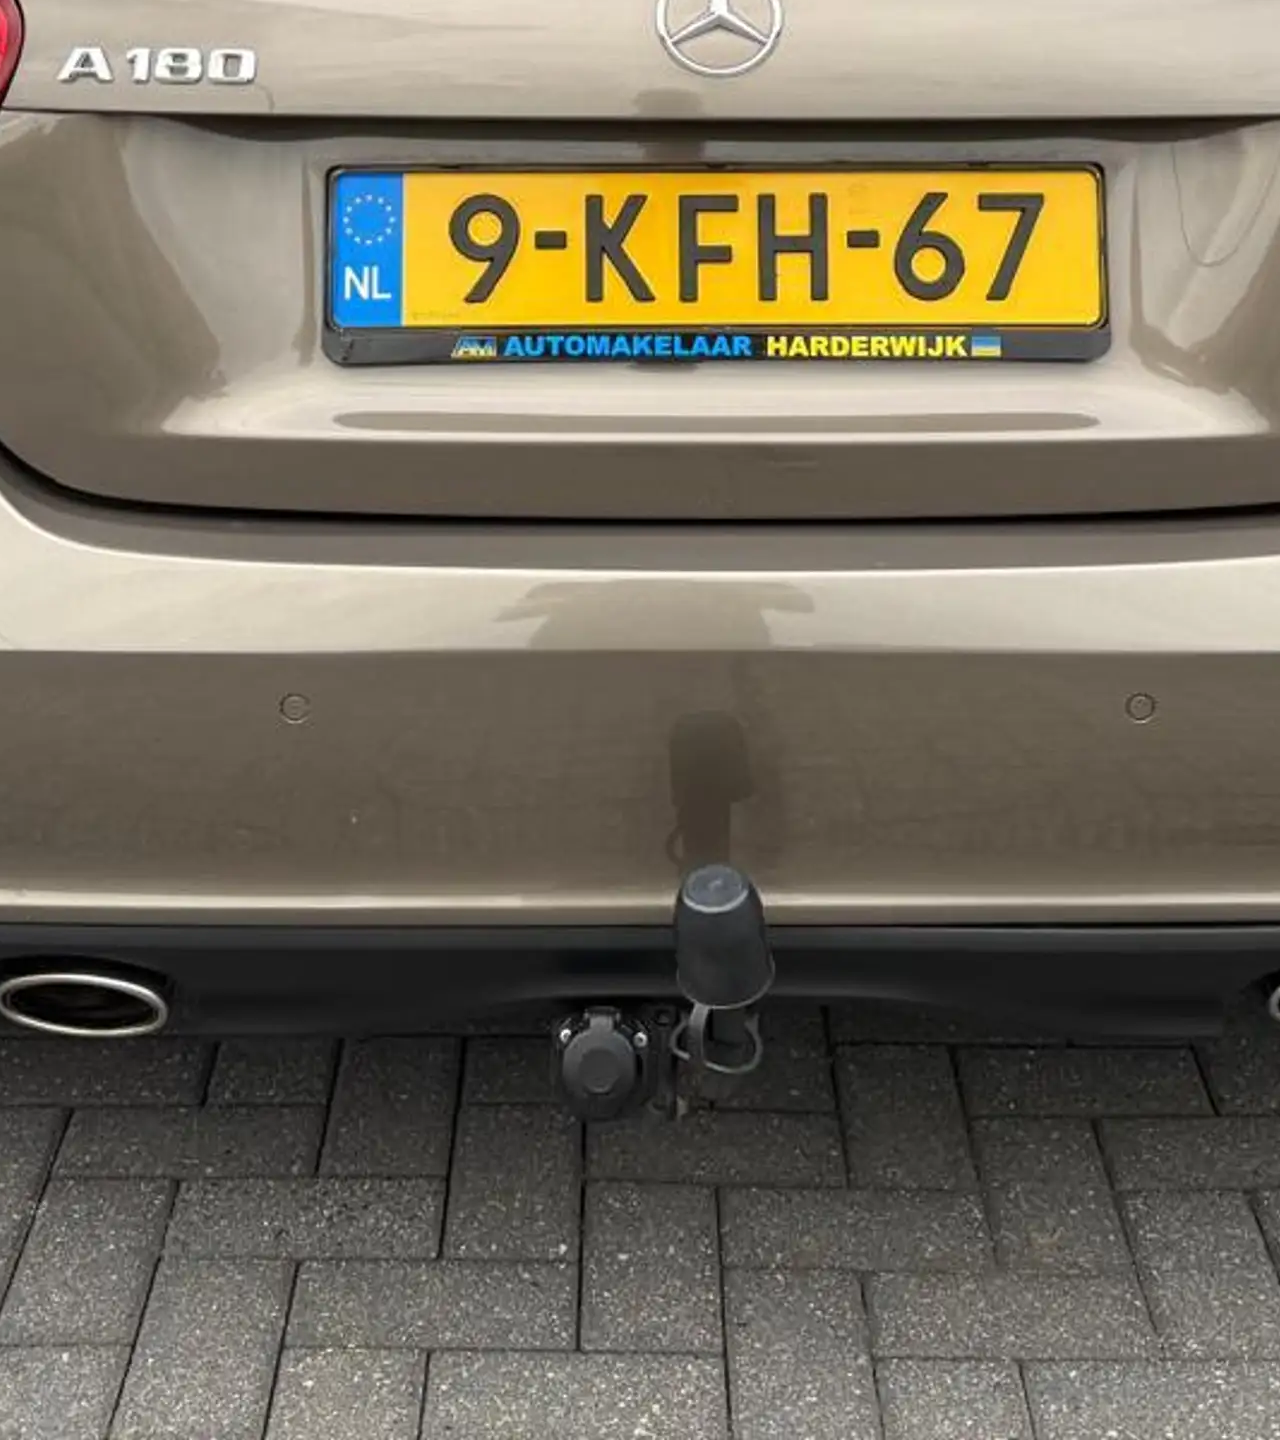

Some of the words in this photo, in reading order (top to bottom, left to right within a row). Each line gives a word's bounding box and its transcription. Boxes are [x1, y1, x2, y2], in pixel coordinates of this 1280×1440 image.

[56, 46, 115, 84] A
[125, 47, 257, 85] 180
[448, 191, 1046, 304] 9-KFH-67
[344, 264, 392, 300] NL
[504, 334, 752, 358] AUTOMAKELAAR
[766, 334, 967, 358] HARDERWIJK
